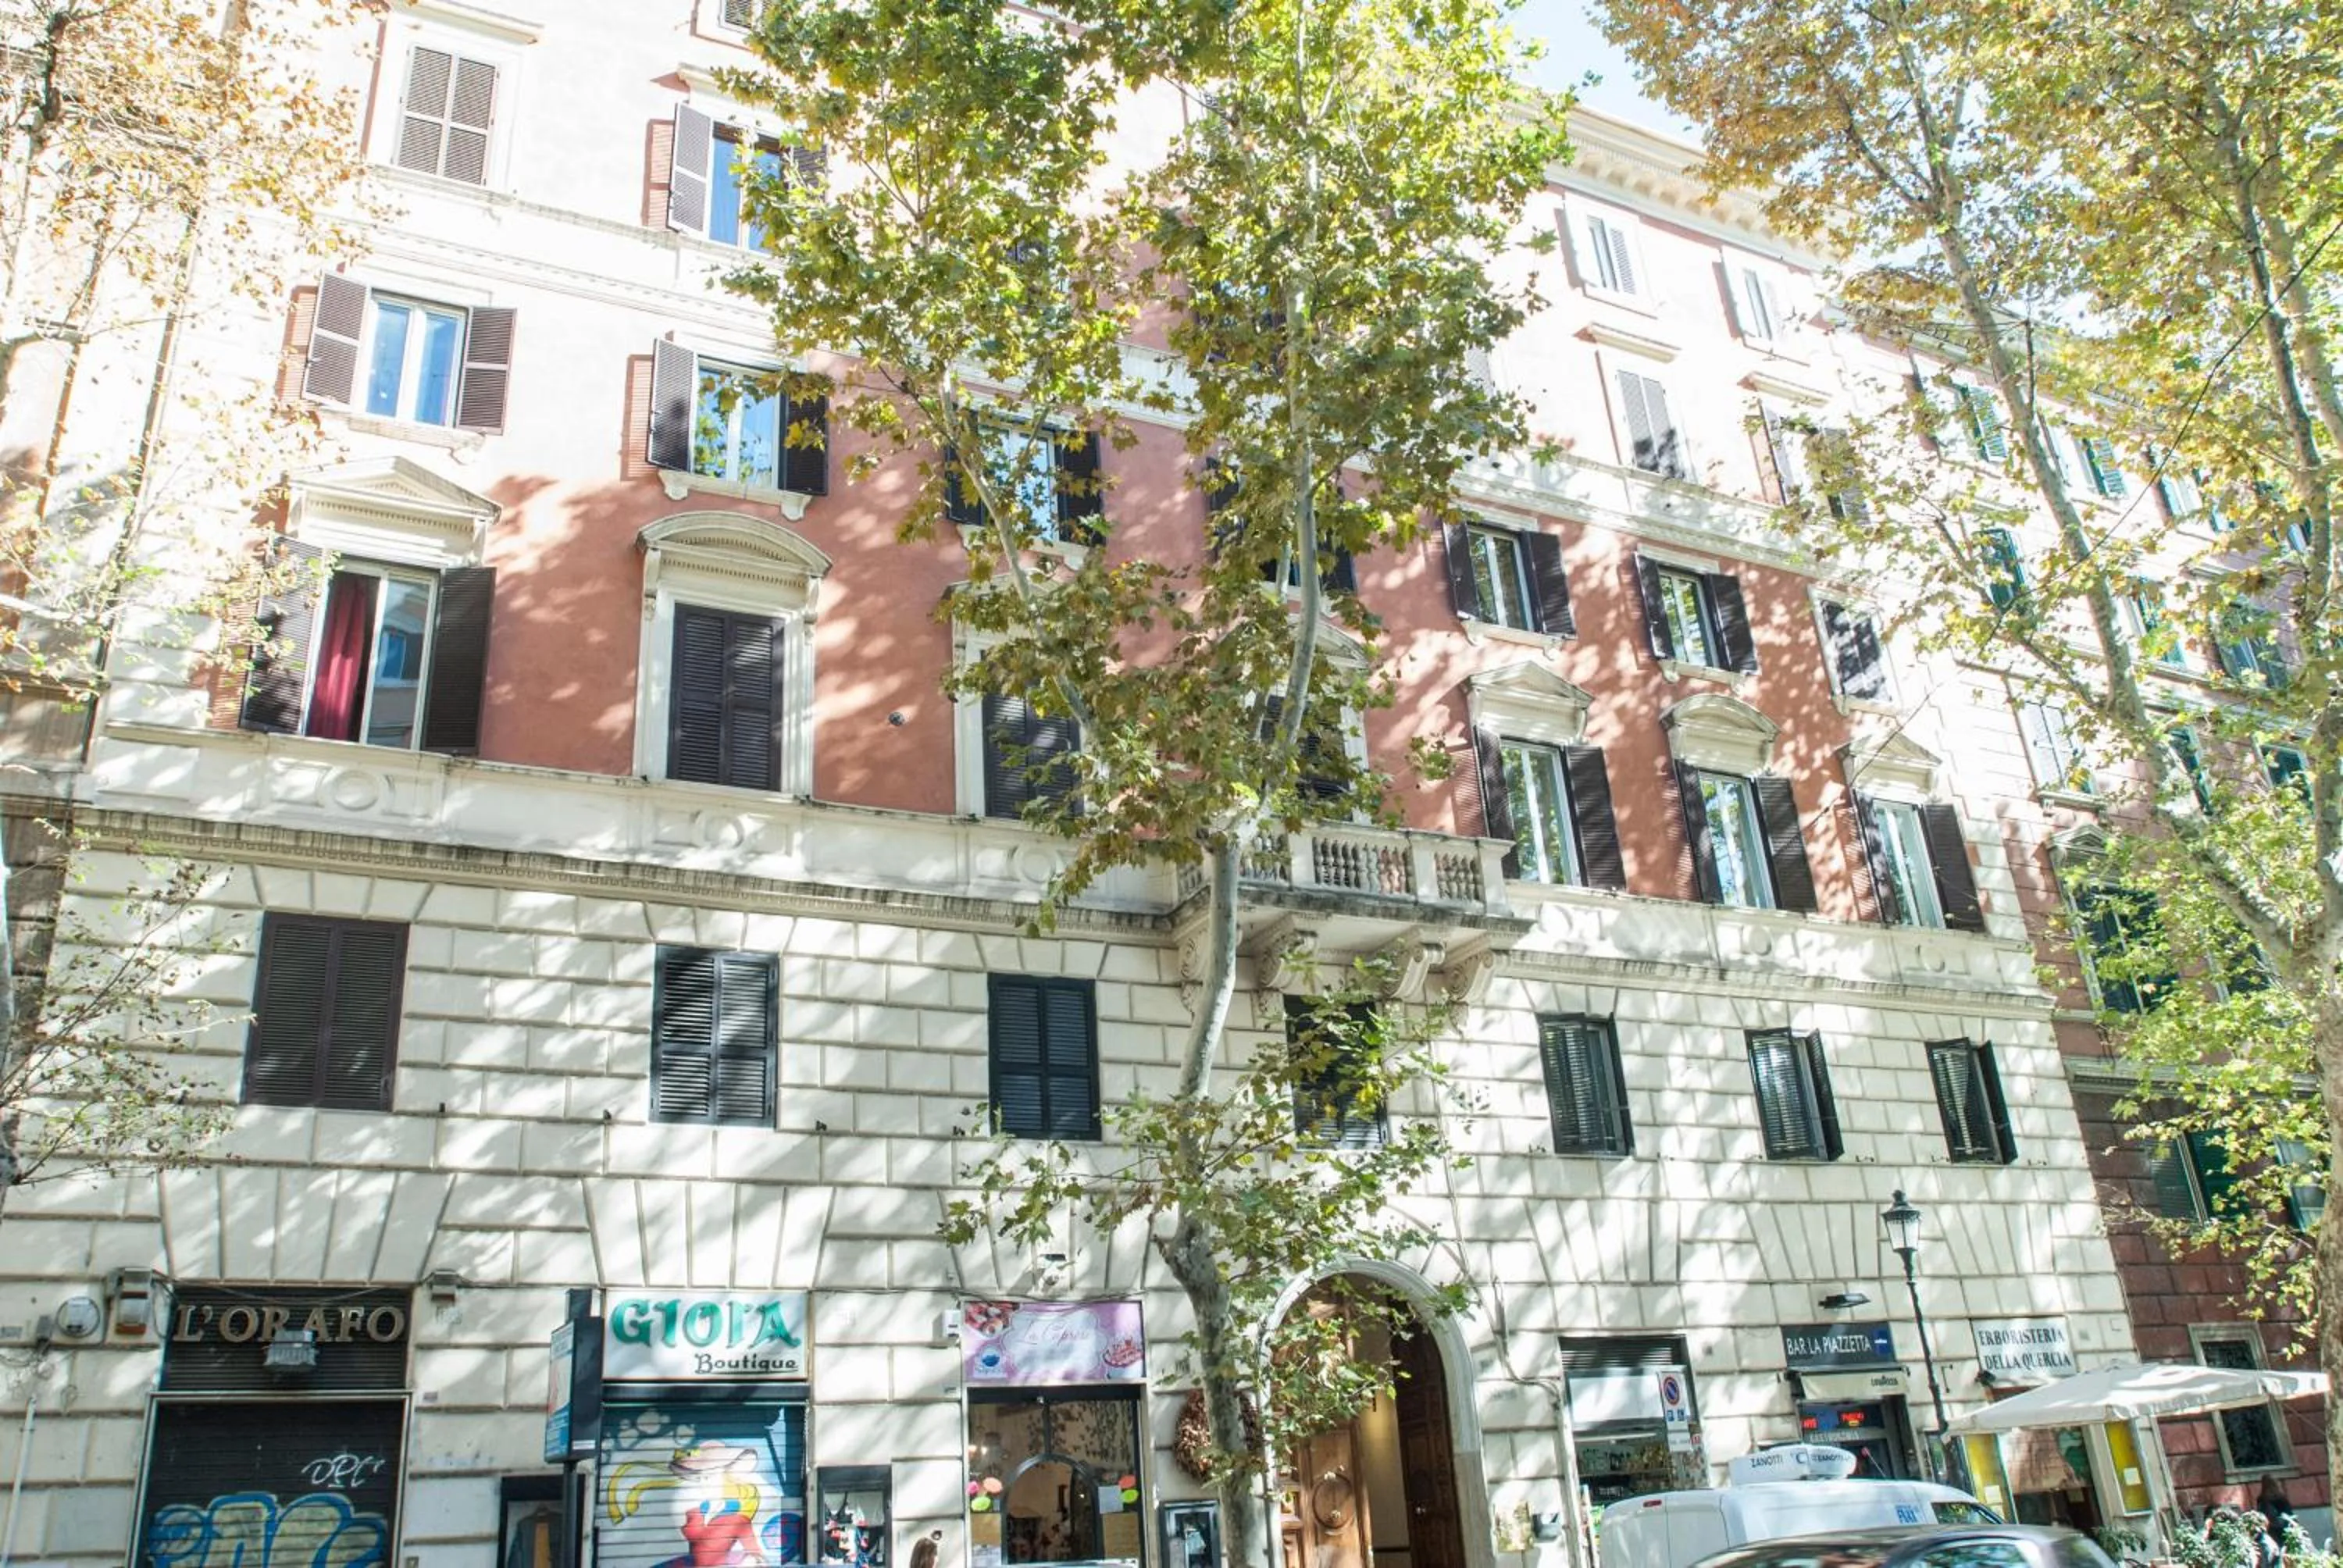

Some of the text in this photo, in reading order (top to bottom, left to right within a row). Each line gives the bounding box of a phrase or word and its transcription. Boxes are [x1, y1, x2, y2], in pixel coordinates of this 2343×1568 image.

[173, 1305, 405, 1342] L'ORAFO
[1786, 1335, 1872, 1355] BAR LA PIAZZETTA
[1977, 1327, 2065, 1345] ERBORISTERIA
[694, 1353, 798, 1374] Boutique
[1983, 1351, 2071, 1370] DELLA QUERCIA
[1750, 1454, 1783, 1467] ZANOTTI
